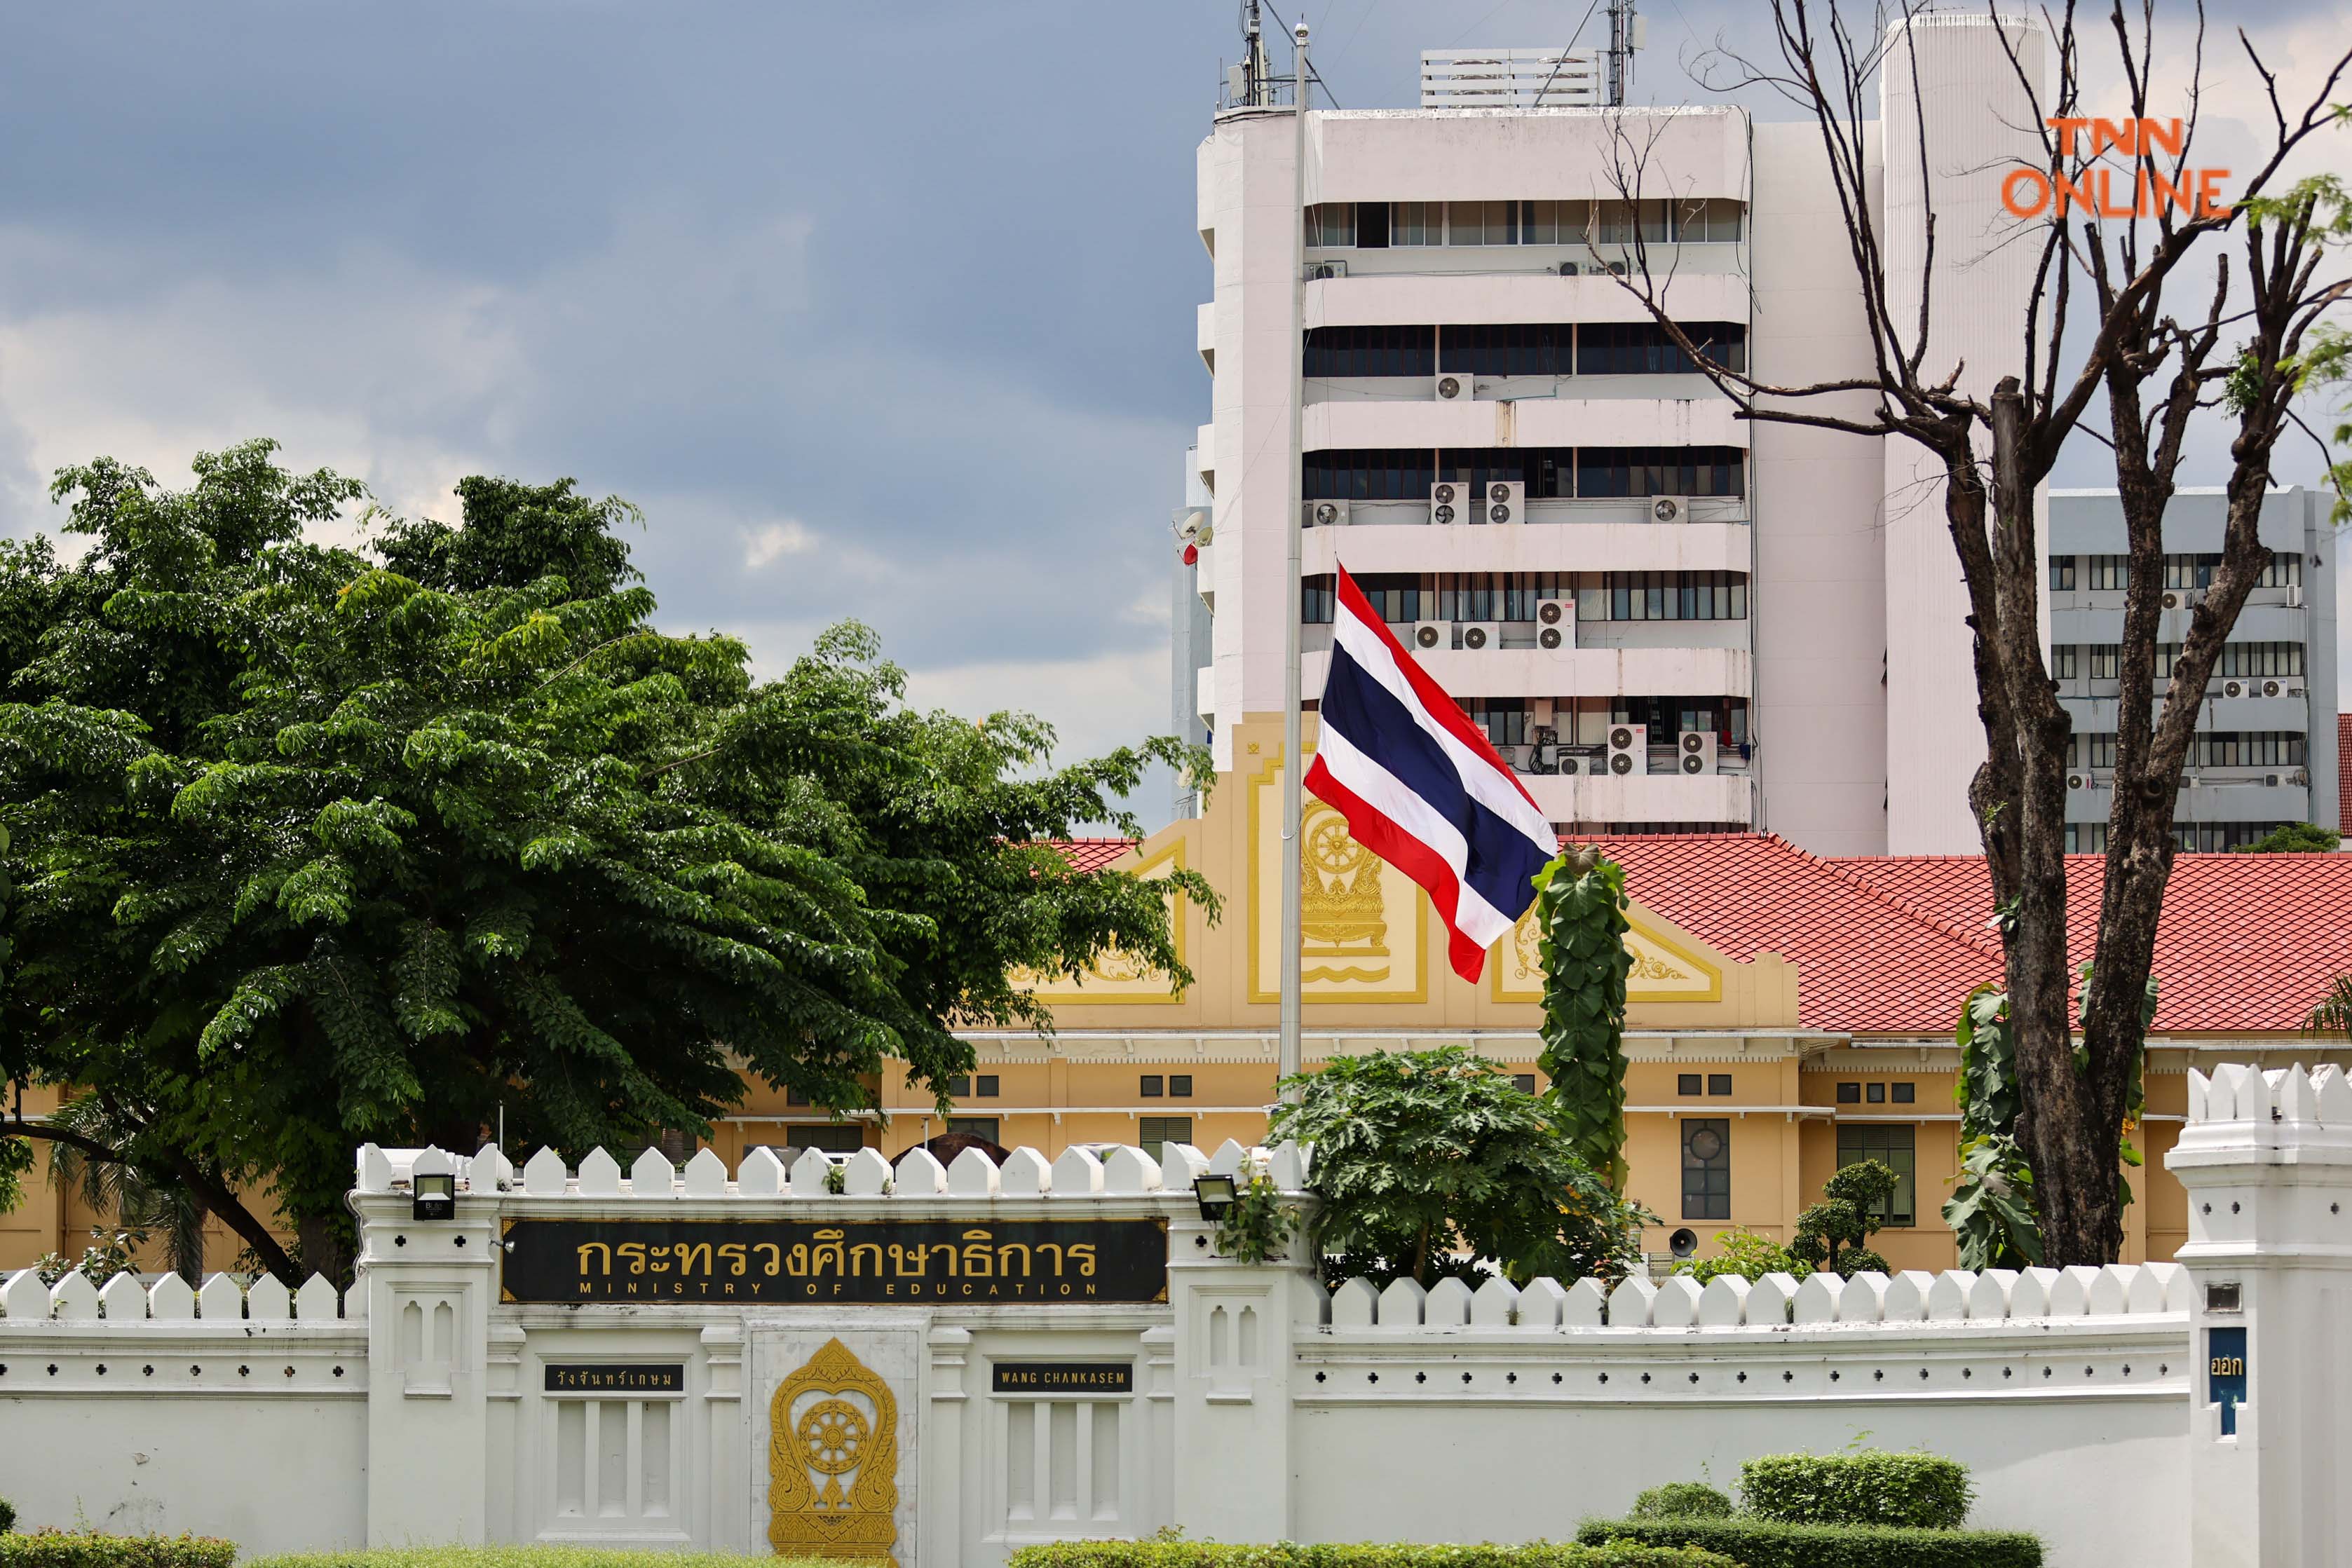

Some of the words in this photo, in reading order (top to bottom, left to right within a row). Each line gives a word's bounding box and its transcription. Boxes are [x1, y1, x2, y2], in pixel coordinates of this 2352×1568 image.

[577, 1228, 1096, 1277] กระทรวงศึกษาธิการ
[580, 1282, 761, 1294] MINISTRY
[807, 1283, 842, 1295] OF
[886, 1283, 1096, 1295] EDUCATION
[2211, 1357, 2243, 1376] ออก
[557, 1370, 671, 1385] วังจันทร์เกษม
[1002, 1372, 1038, 1384] WANG
[1044, 1372, 1124, 1384] CHANKASEM
